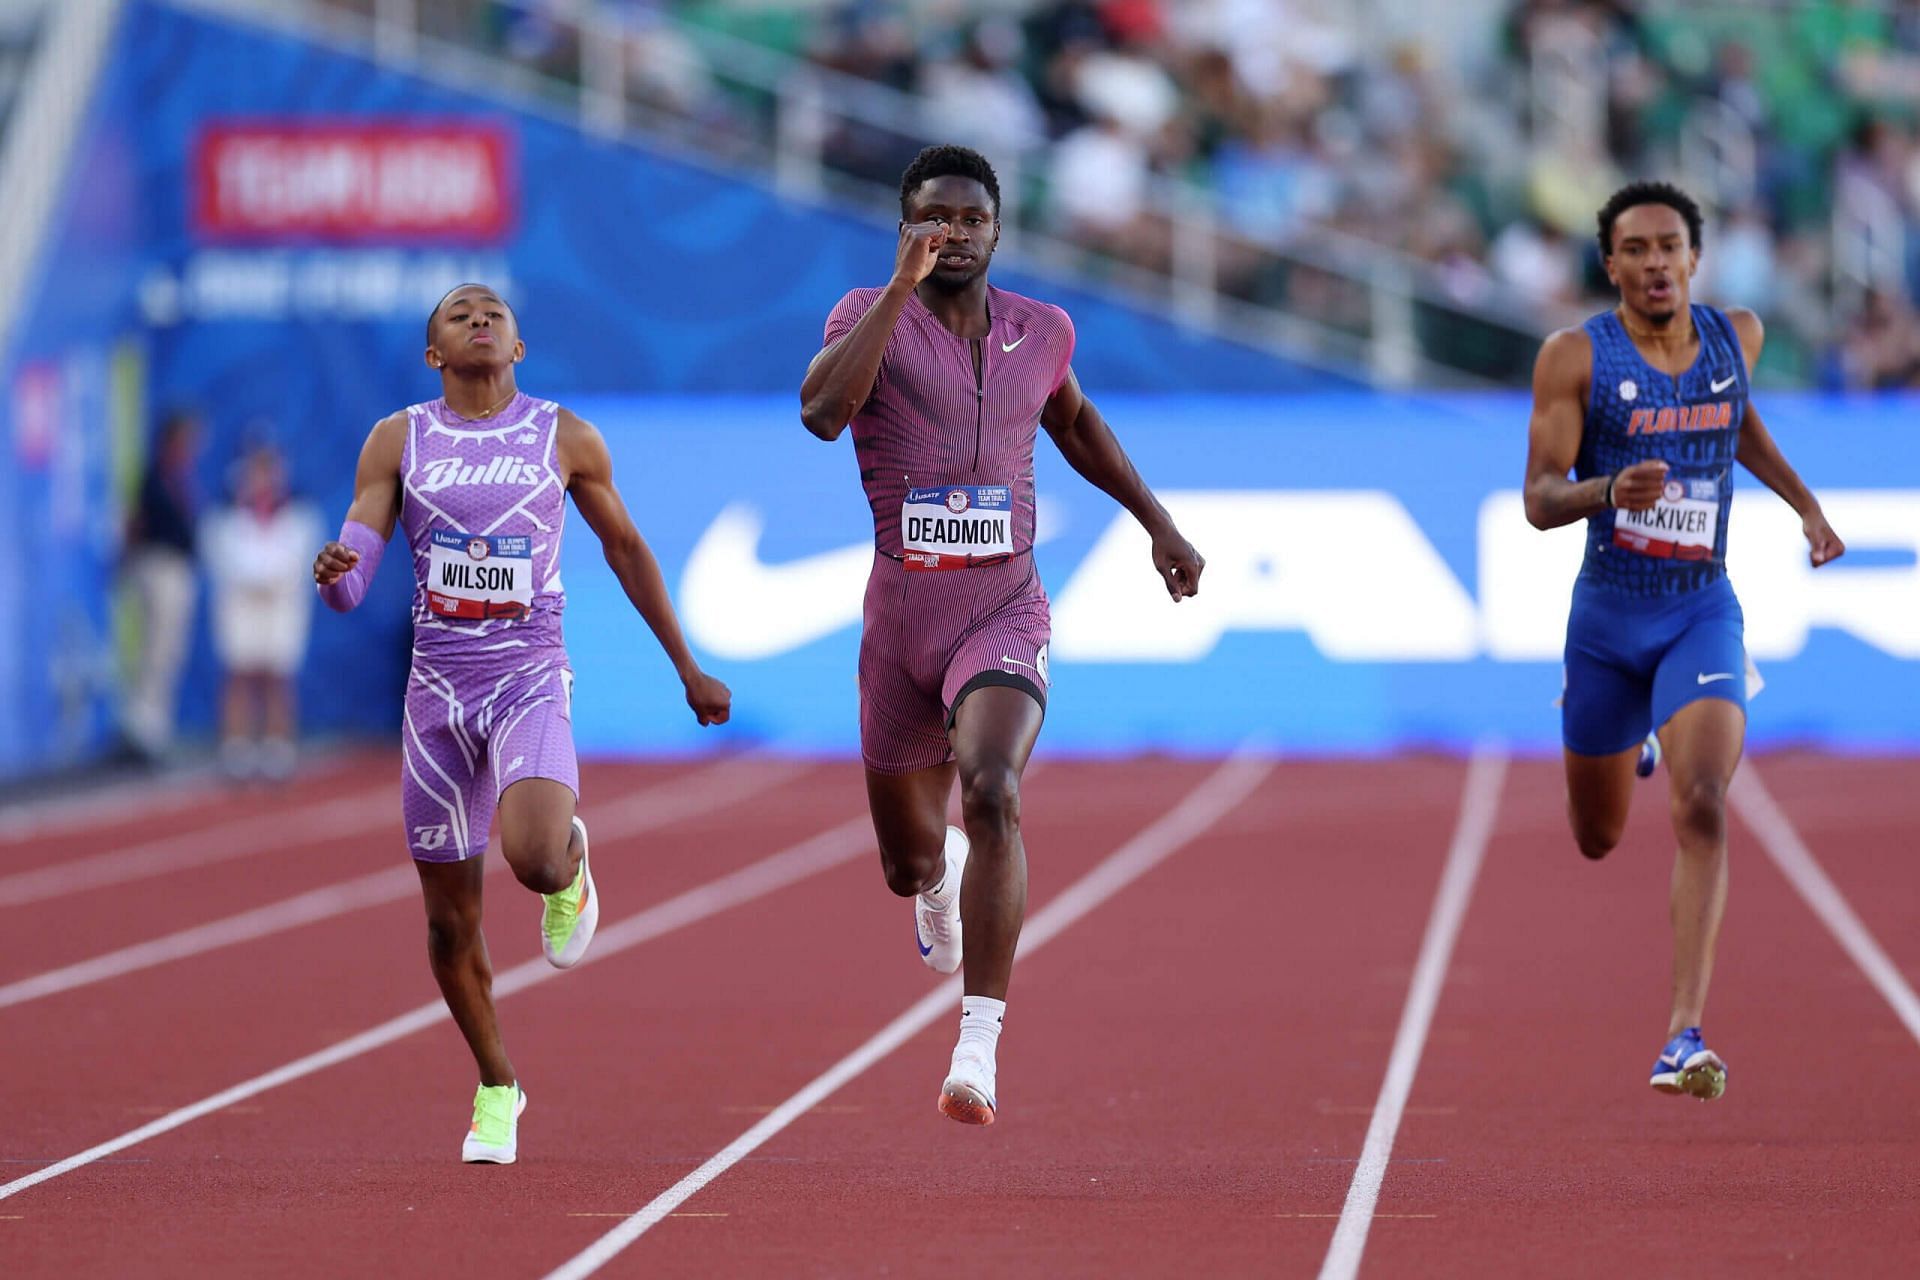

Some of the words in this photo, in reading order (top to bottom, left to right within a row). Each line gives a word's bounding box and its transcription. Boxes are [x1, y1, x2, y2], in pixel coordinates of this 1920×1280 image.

[1627, 402, 1733, 436] FLORIDA
[417, 456, 542, 493] Bullis
[908, 517, 1005, 544] DEADMON
[1626, 506, 1708, 533] MCKIVER
[442, 562, 514, 592] WILSON
[412, 824, 448, 851] B
